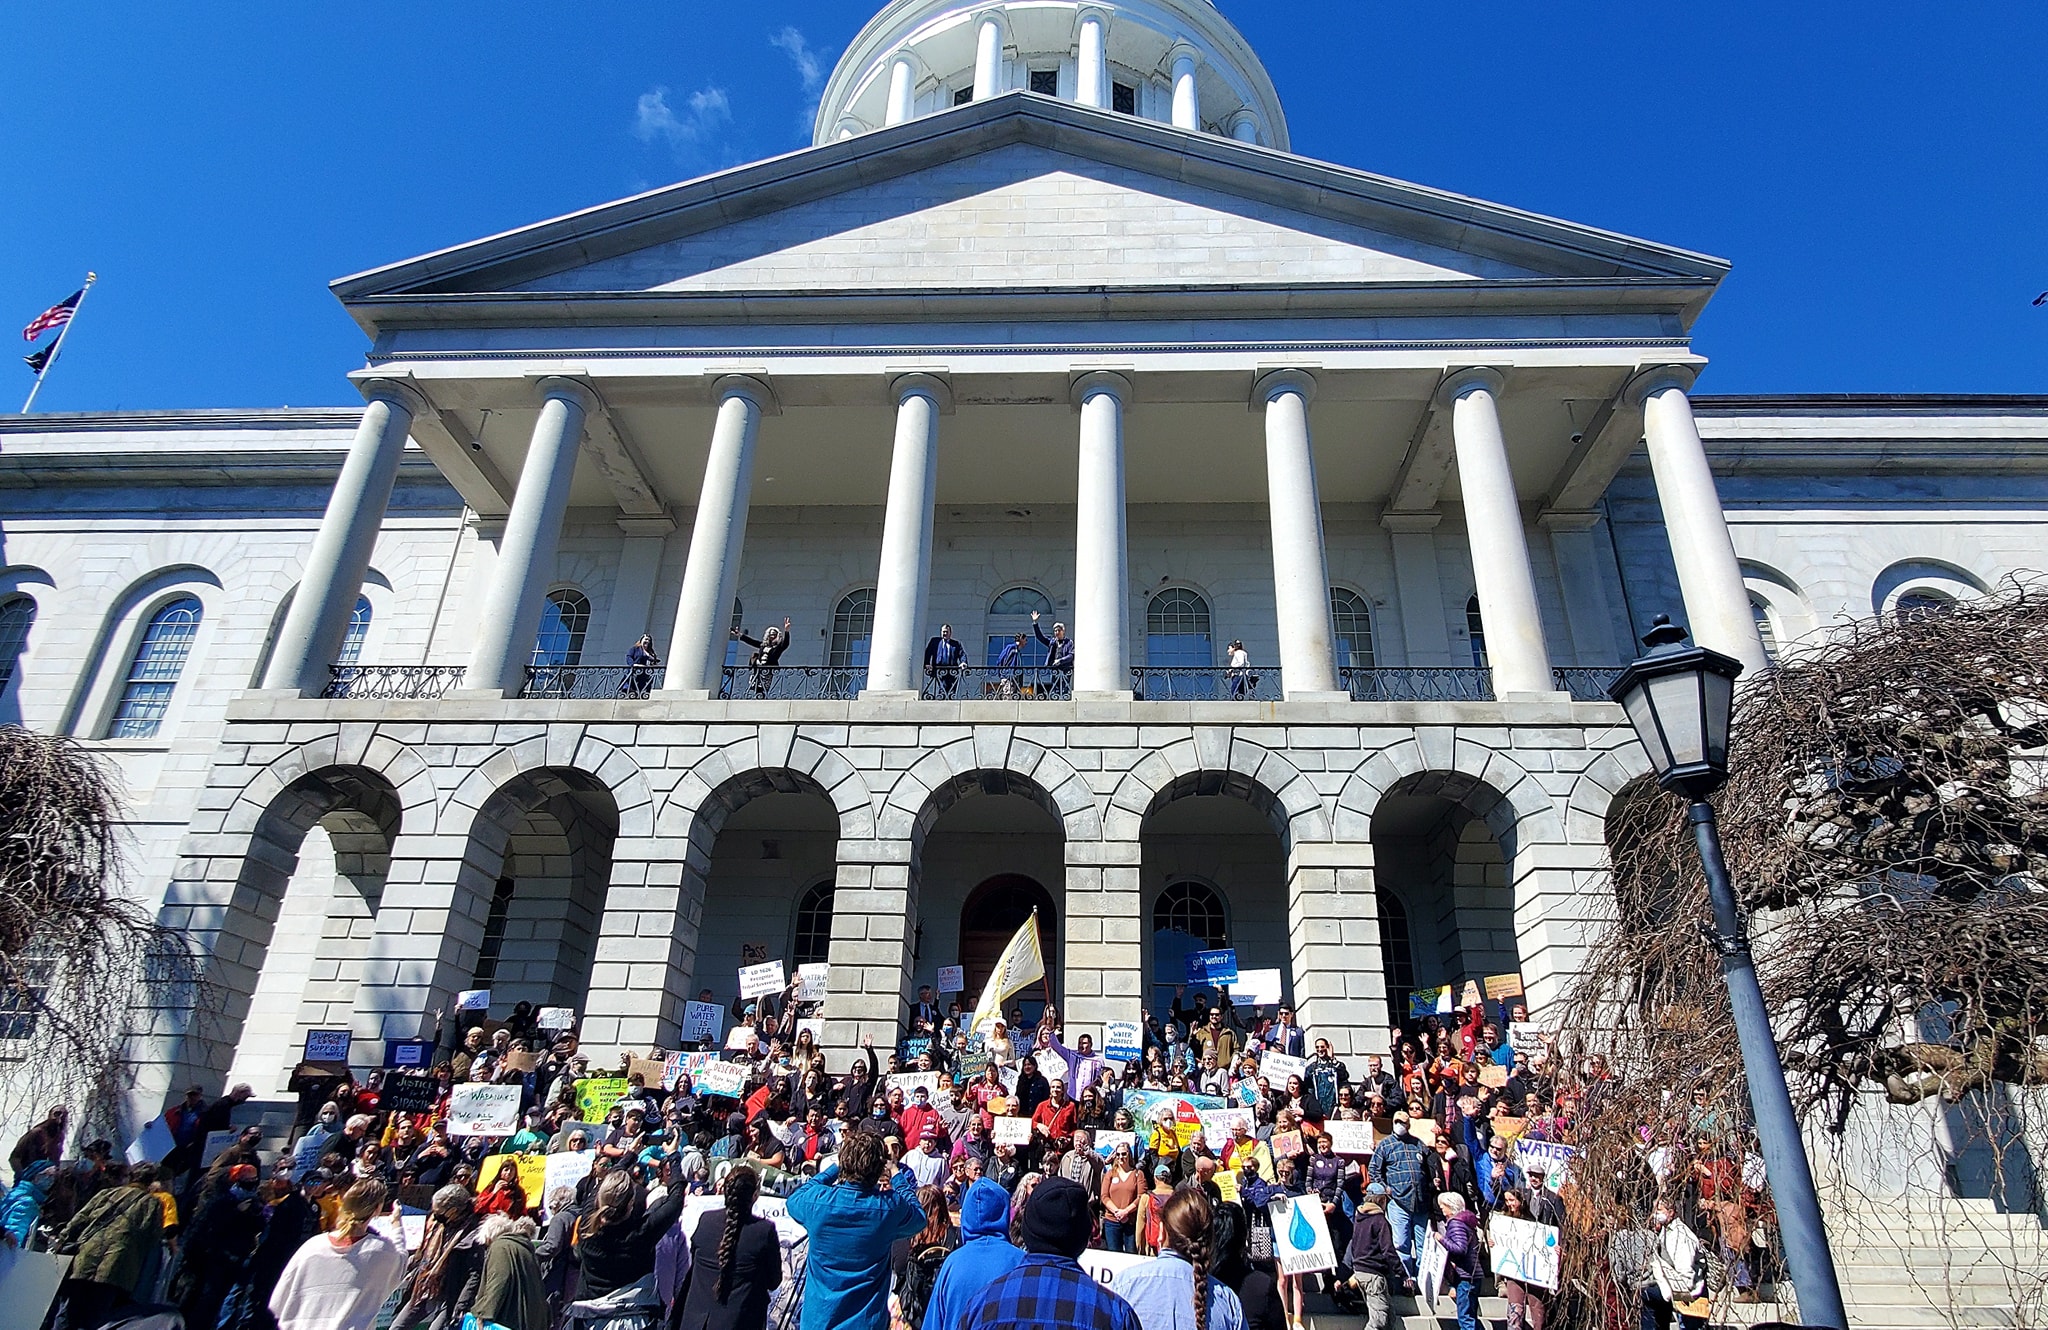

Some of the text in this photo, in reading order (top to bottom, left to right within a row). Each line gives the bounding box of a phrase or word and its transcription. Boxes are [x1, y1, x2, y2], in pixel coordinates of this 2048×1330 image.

[743, 944, 766, 960] Pass
[1192, 954, 1229, 971] got water?
[697, 1004, 715, 1013] PURE
[690, 1012, 715, 1021] WATER
[311, 1032, 348, 1040] SUPPORT
[692, 1027, 712, 1036] LIFE
[1113, 1031, 1133, 1039] WATER
[1108, 1037, 1134, 1045] JUSTICE
[309, 1044, 346, 1052] SUPPORT
[396, 1076, 434, 1090] JUSTICE
[1273, 1135, 1302, 1155] 906
[1516, 1139, 1575, 1161] WATER
[517, 1156, 534, 1165] 906
